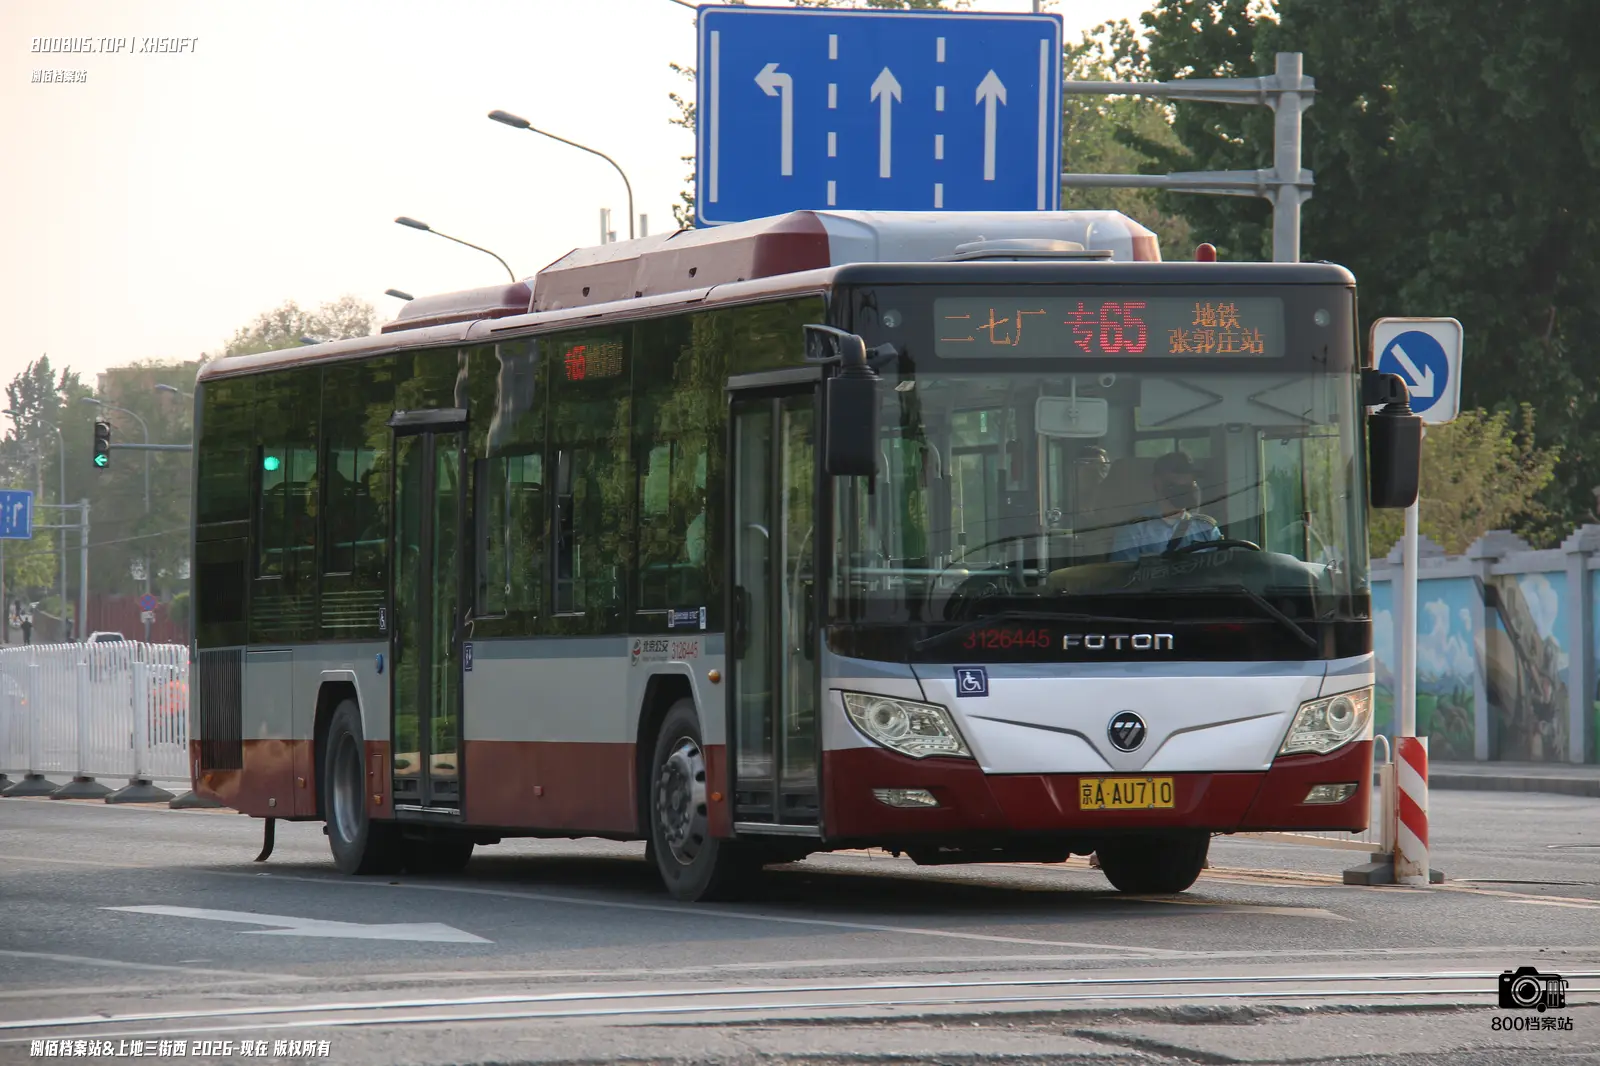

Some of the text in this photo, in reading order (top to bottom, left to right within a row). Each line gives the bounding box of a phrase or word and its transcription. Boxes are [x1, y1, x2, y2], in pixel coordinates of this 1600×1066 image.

[940, 308, 1047, 347] 二七厂
[1191, 301, 1242, 330] 地铁
[1167, 327, 1266, 355] 张郭庄站
[671, 641, 699, 660] 3126445
[963, 629, 1051, 650] 3126445
[1062, 633, 1176, 651] FOTON
